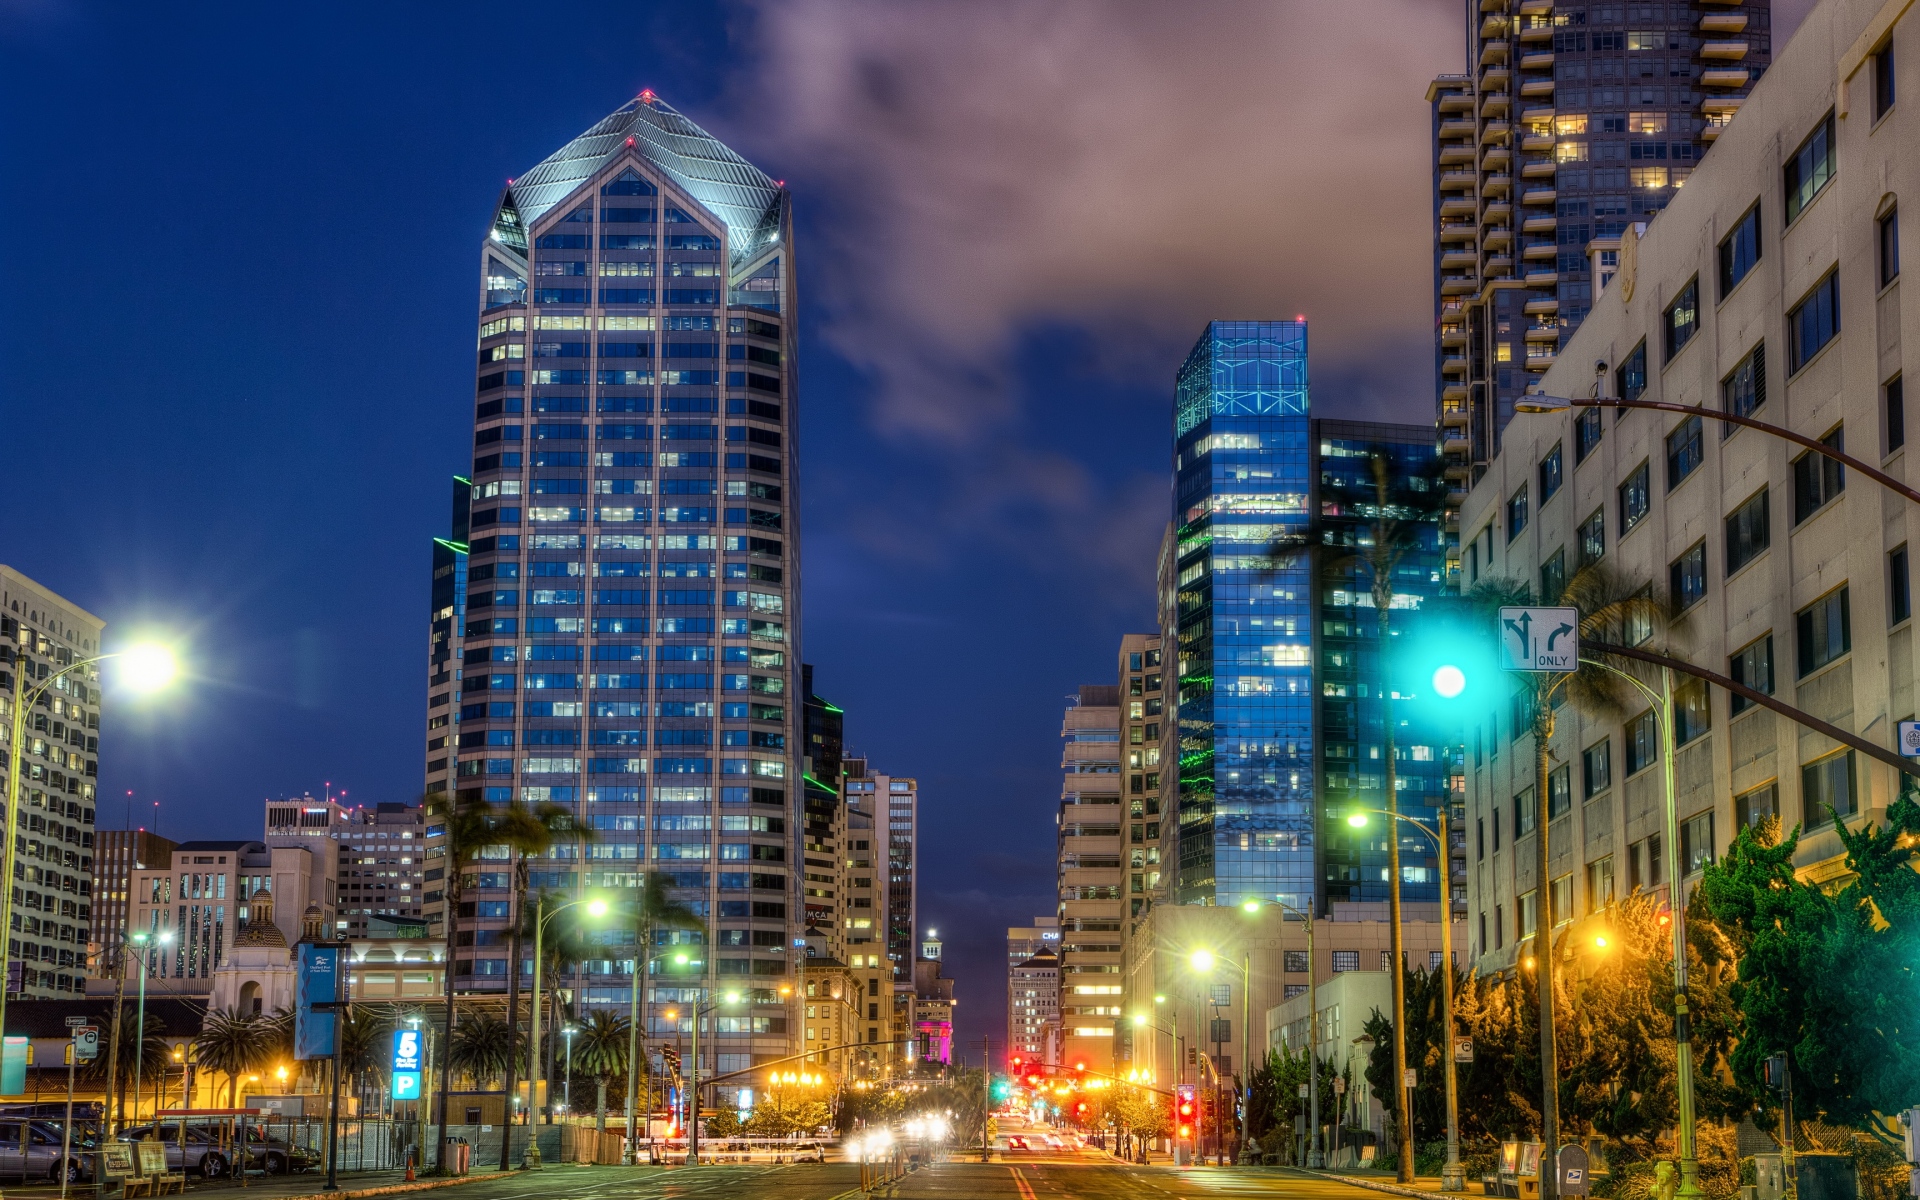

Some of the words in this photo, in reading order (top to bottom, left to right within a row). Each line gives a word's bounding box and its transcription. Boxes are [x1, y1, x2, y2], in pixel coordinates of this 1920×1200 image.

[1538, 655, 1568, 666] ONLY
[805, 911, 827, 919] MCA
[398, 1032, 418, 1058] 5
[397, 1075, 414, 1095] P
